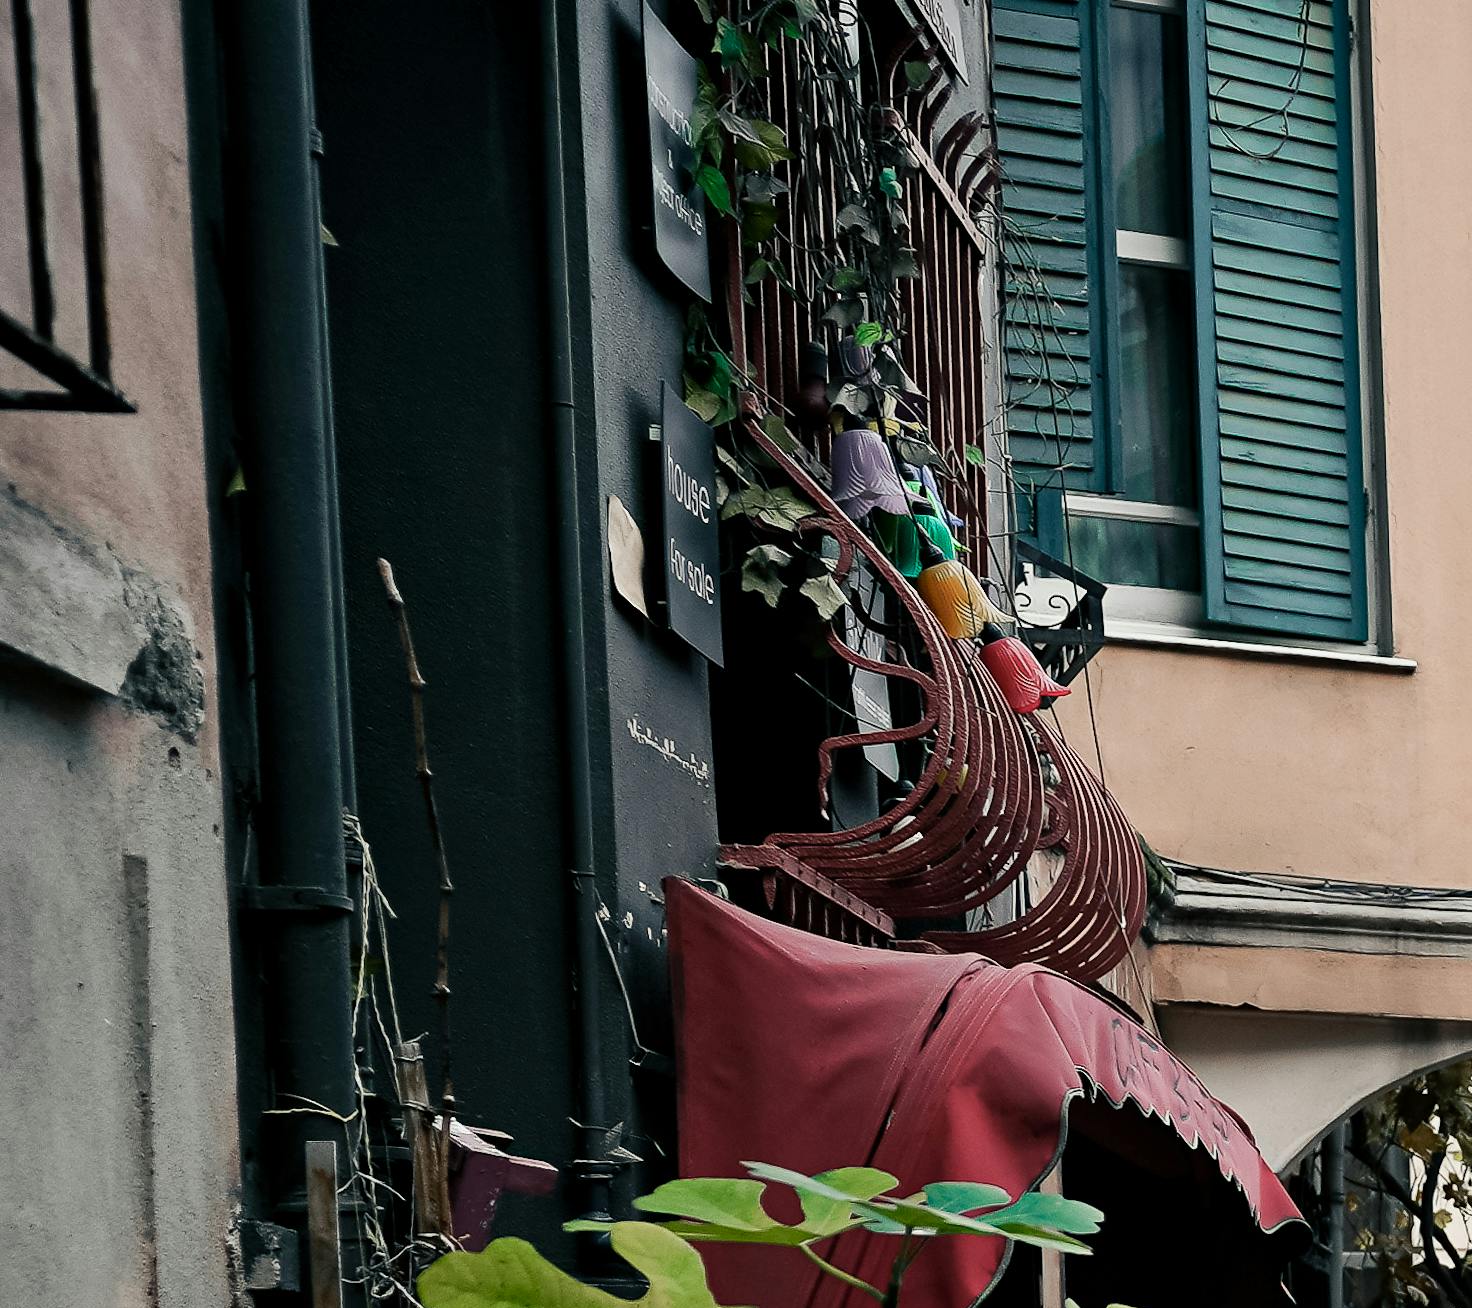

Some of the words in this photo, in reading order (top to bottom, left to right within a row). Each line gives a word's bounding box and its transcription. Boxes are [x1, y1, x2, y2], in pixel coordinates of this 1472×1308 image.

[665, 443, 711, 525] house
[669, 536, 687, 584] for
[686, 561, 715, 607] sale
